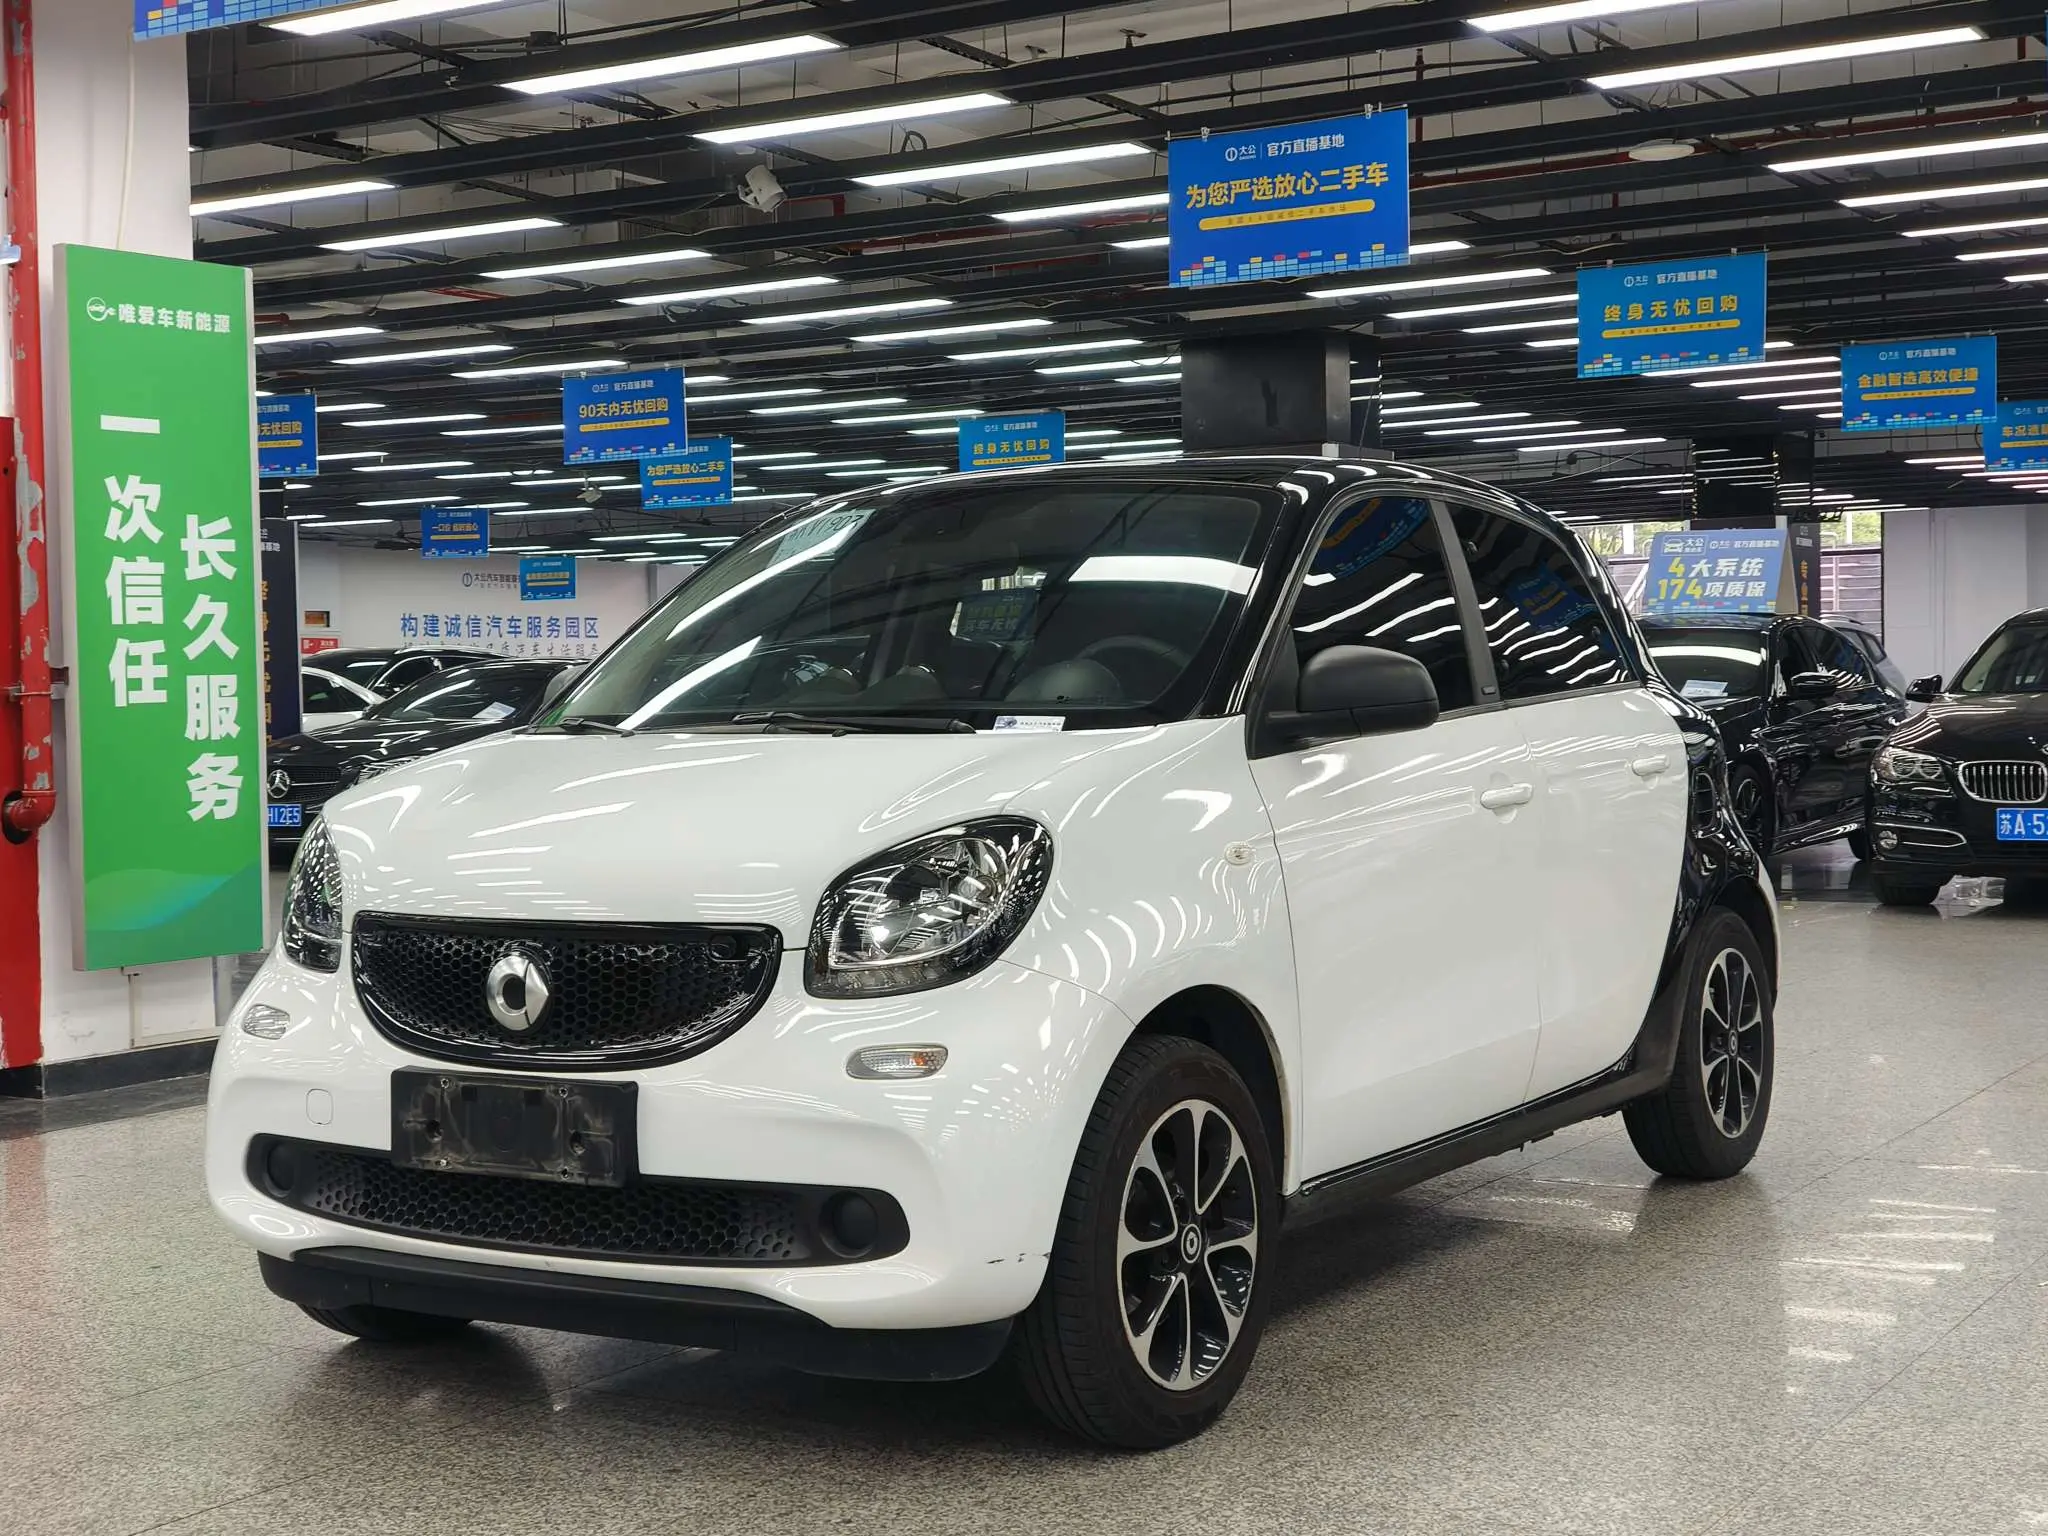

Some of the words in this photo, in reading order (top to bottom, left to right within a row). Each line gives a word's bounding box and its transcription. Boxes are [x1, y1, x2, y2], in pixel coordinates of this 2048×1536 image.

[1239, 144, 1256, 155] 大公
[1266, 134, 1345, 157] 官方直播基地
[1186, 162, 1389, 209] 为您严选放心二手车
[1657, 269, 1718, 285] 官方直播基地
[117, 303, 231, 333] 唯爱车新能源
[1603, 295, 1738, 322] 终身无忧回购
[578, 398, 669, 418] 90天内无忧回购
[258, 421, 302, 435] 无忧回购
[647, 461, 726, 477] 为您严选放心二手车
[100, 414, 169, 707] 一次信任
[1668, 556, 1765, 578] 4大系统
[1658, 578, 1766, 600] 174项质保
[400, 613, 600, 639] 构建诚信汽车服务园区
[181, 514, 244, 821] 长久服务
[2000, 813, 2048, 835] 苏A·5
